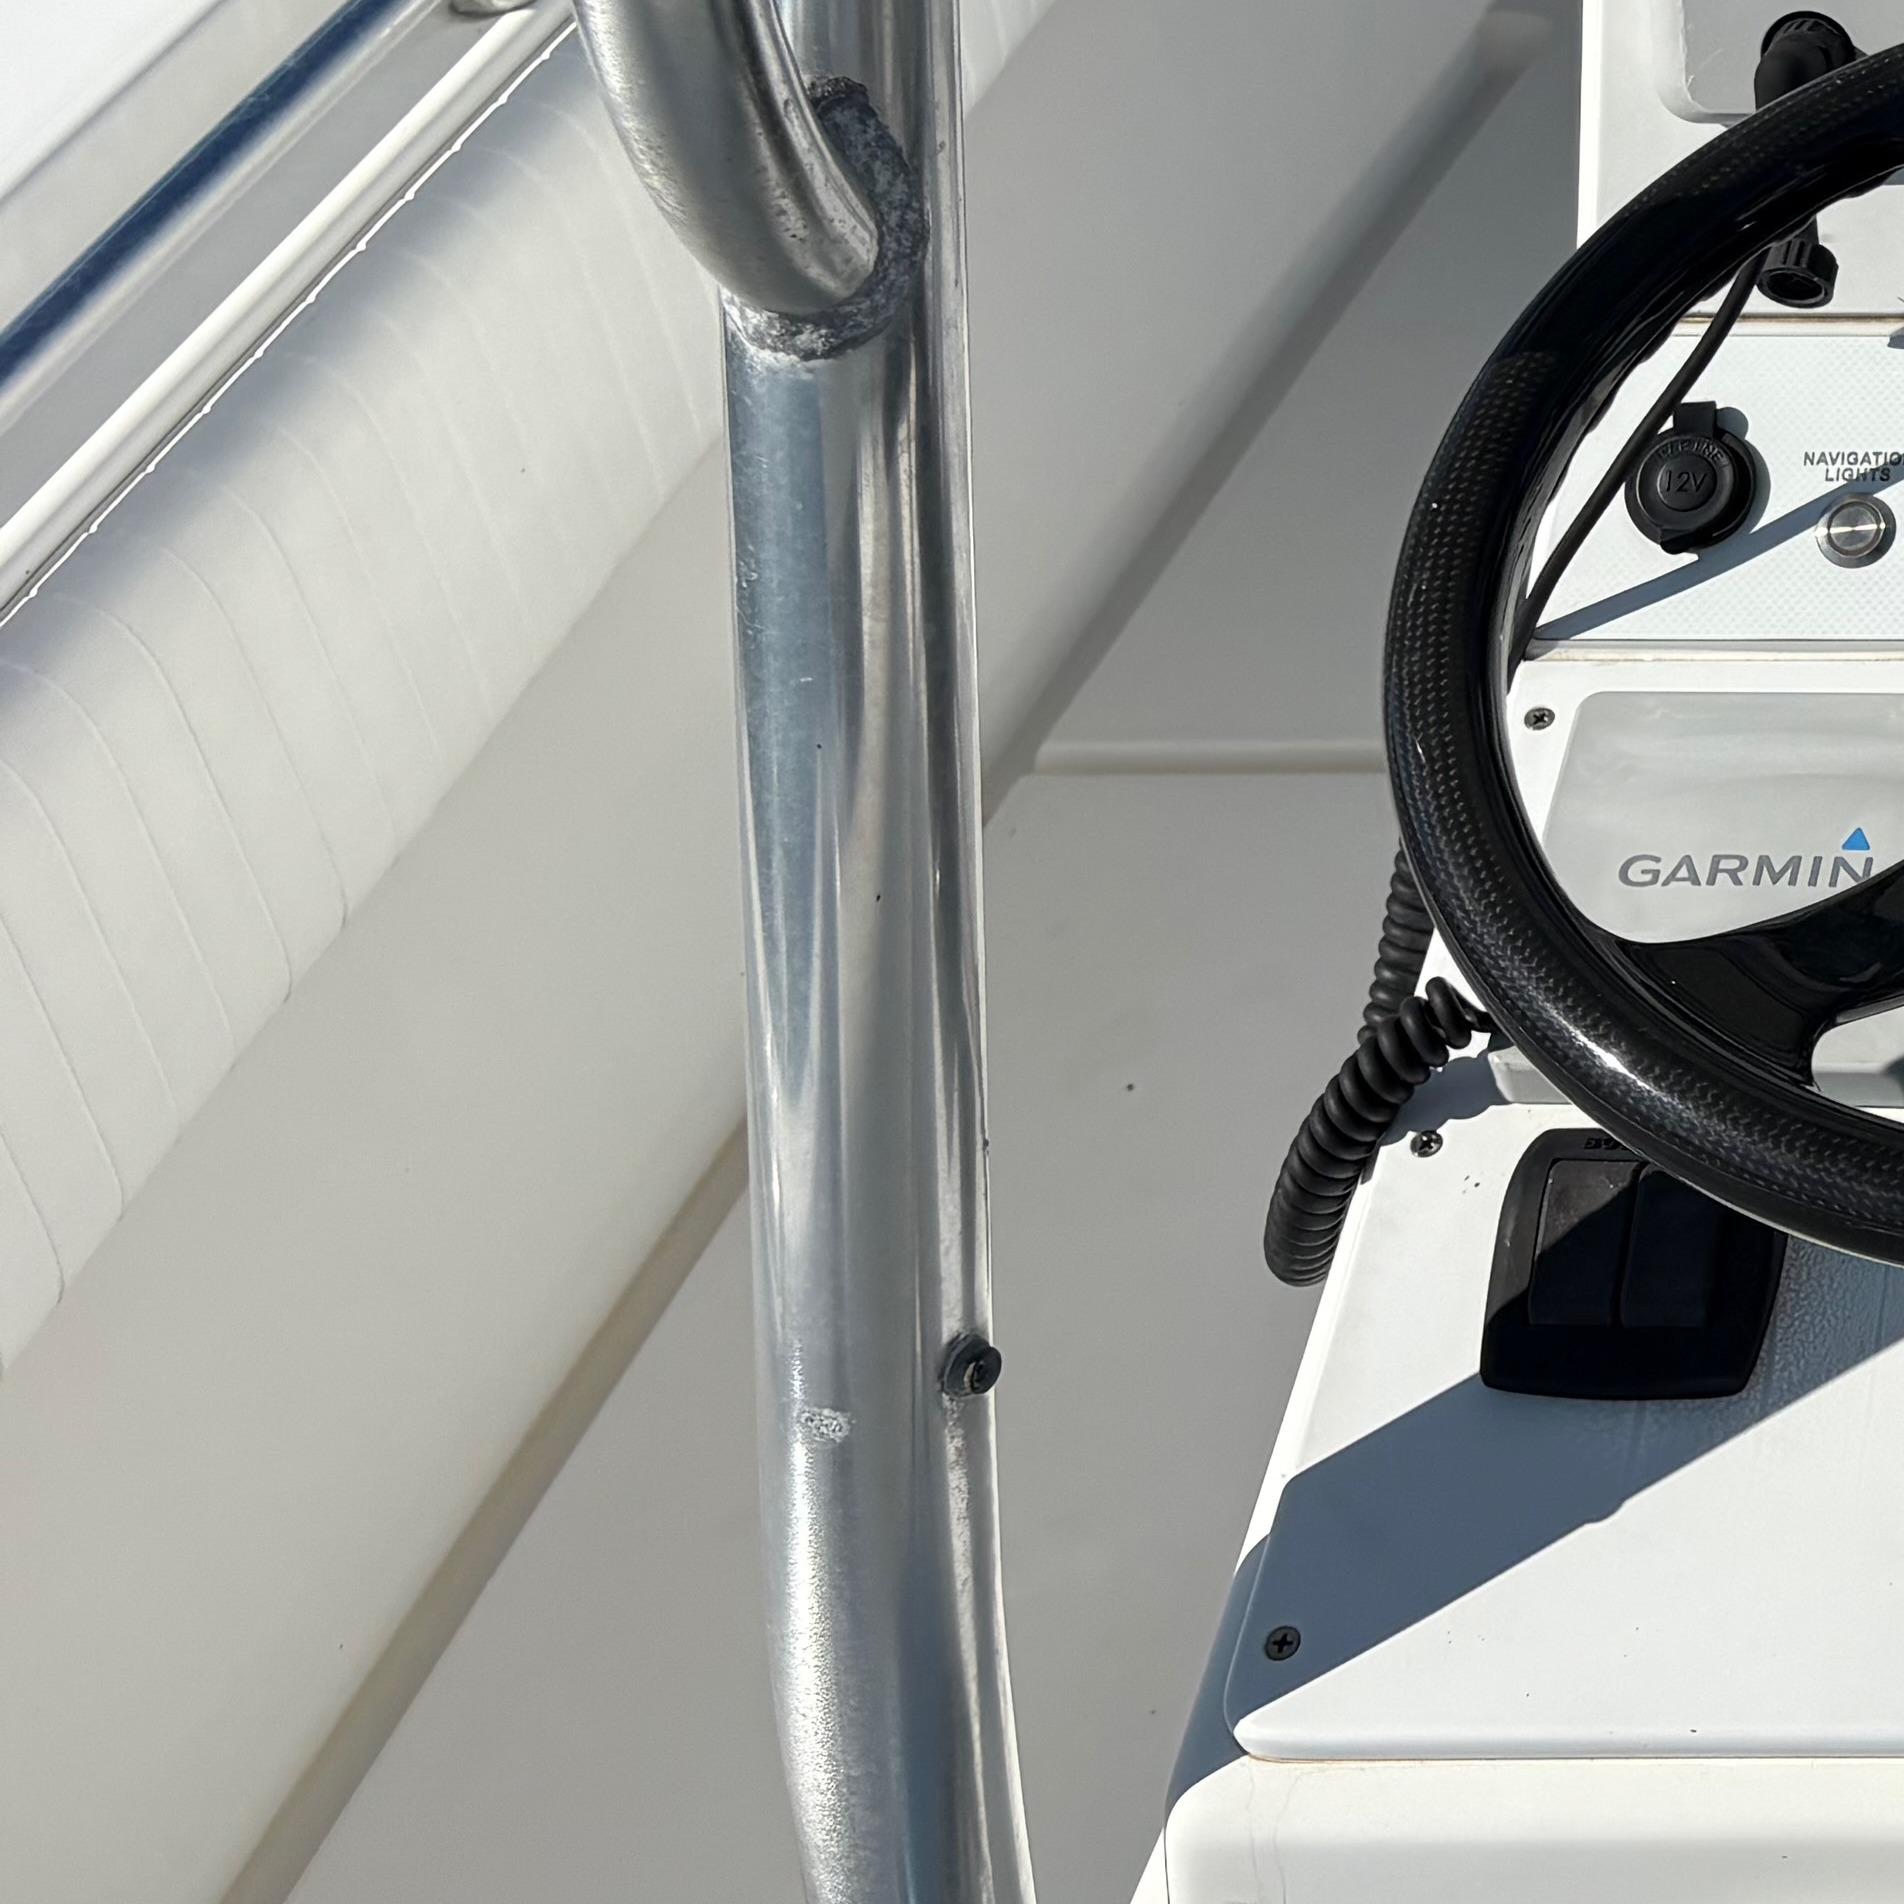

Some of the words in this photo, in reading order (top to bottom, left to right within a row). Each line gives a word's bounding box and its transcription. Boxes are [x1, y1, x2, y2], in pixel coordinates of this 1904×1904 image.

[1665, 469, 1708, 493] 12V
[1824, 467, 1891, 482] LIGHTS
[1617, 853, 1874, 888] GARMIN
